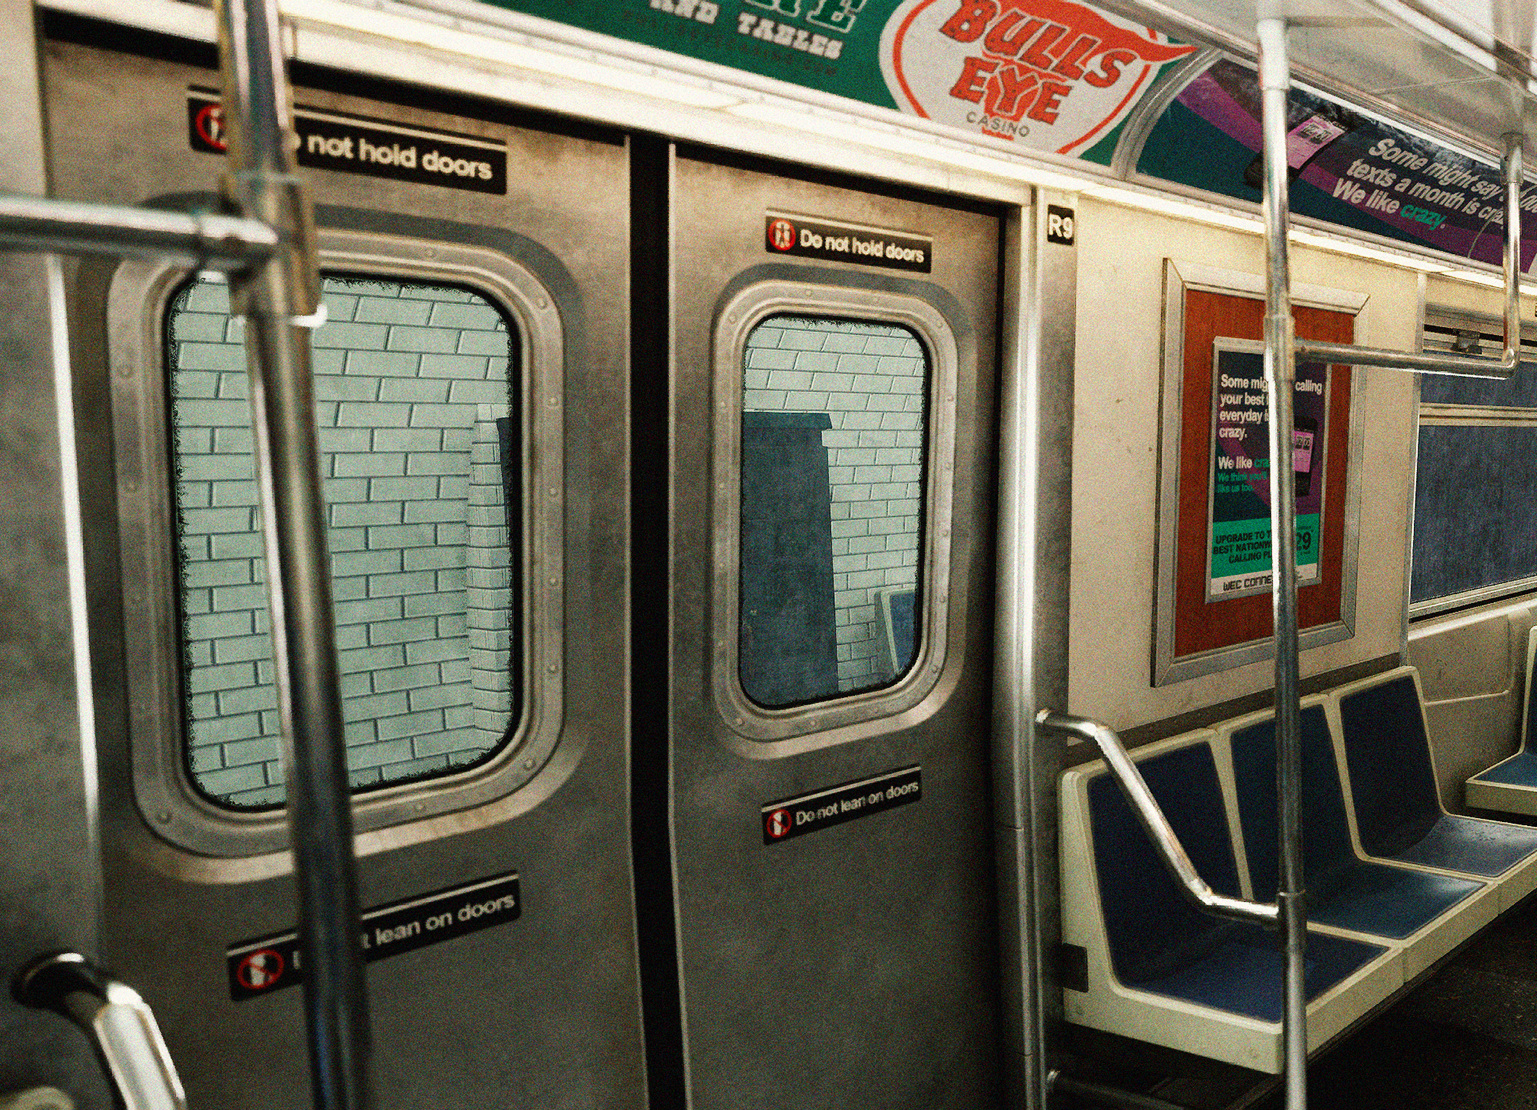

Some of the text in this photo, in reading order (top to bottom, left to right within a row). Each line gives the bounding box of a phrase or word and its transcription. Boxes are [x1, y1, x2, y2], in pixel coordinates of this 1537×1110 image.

[737, 11, 843, 60] TABLES
[938, 0, 1138, 89] BULLS
[948, 56, 1074, 126] EYE
[965, 111, 1031, 138] CASINO
[307, 133, 354, 160] not
[359, 138, 417, 169] hold
[422, 150, 493, 180] doors
[1368, 138, 1429, 171] Some
[1422, 161, 1481, 189] might
[1470, 180, 1503, 201] say
[1346, 158, 1397, 188] texts
[1394, 178, 1412, 193] a
[1407, 181, 1466, 210] month
[1461, 197, 1481, 215] is
[1332, 177, 1448, 231] We like crazy.
[1048, 213, 1074, 239] R9
[799, 229, 925, 263] Do not hold doors
[1220, 374, 1323, 396] Some mig calling
[1220, 392, 1265, 407] your best
[1219, 409, 1264, 424] everyday
[1219, 427, 1248, 441] crazy.
[1218, 455, 1270, 469] We like cra
[1217, 472, 1230, 482] We
[1230, 471, 1248, 481] think
[1217, 484, 1230, 493] like
[1231, 485, 1240, 493] us
[1213, 544, 1235, 555] BEST
[1215, 532, 1253, 544] UPGRADE
[1254, 530, 1266, 540] TO
[1228, 550, 1273, 564] CALLING PL
[1222, 575, 1273, 592] WEC CONNE
[796, 780, 919, 826] Do not lean on doors
[375, 920, 421, 947] lean
[425, 911, 453, 931] on
[457, 893, 516, 922] doors
